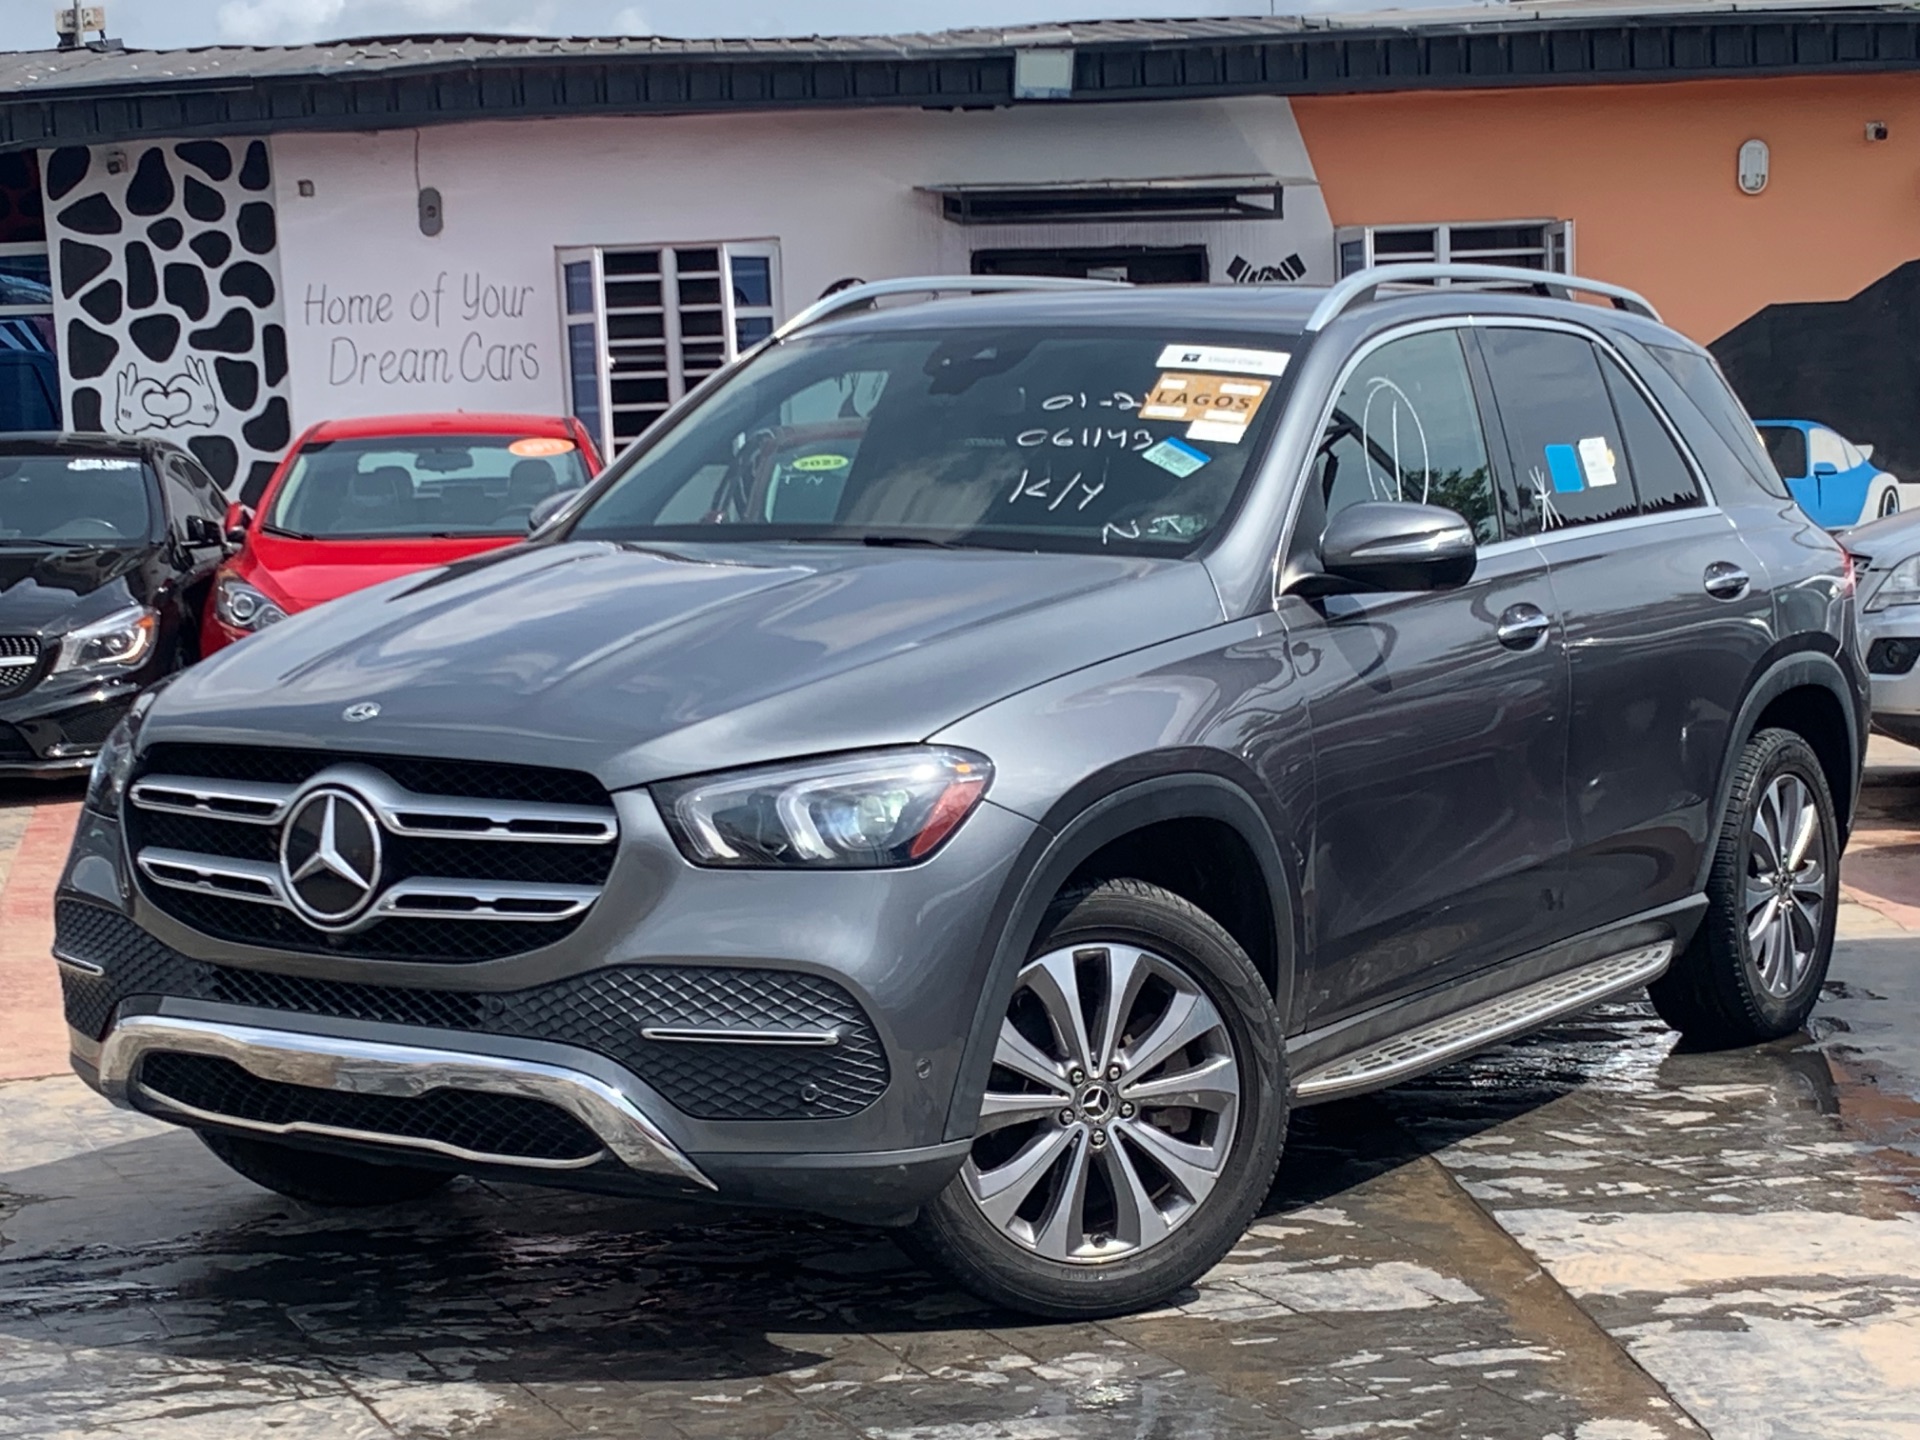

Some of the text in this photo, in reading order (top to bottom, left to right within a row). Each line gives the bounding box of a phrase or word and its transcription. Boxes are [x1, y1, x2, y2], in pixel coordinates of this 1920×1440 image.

[304, 271, 535, 327] Home of Your
[329, 331, 540, 386] Dream Cars
[1155, 391, 1252, 410] LAGOS
